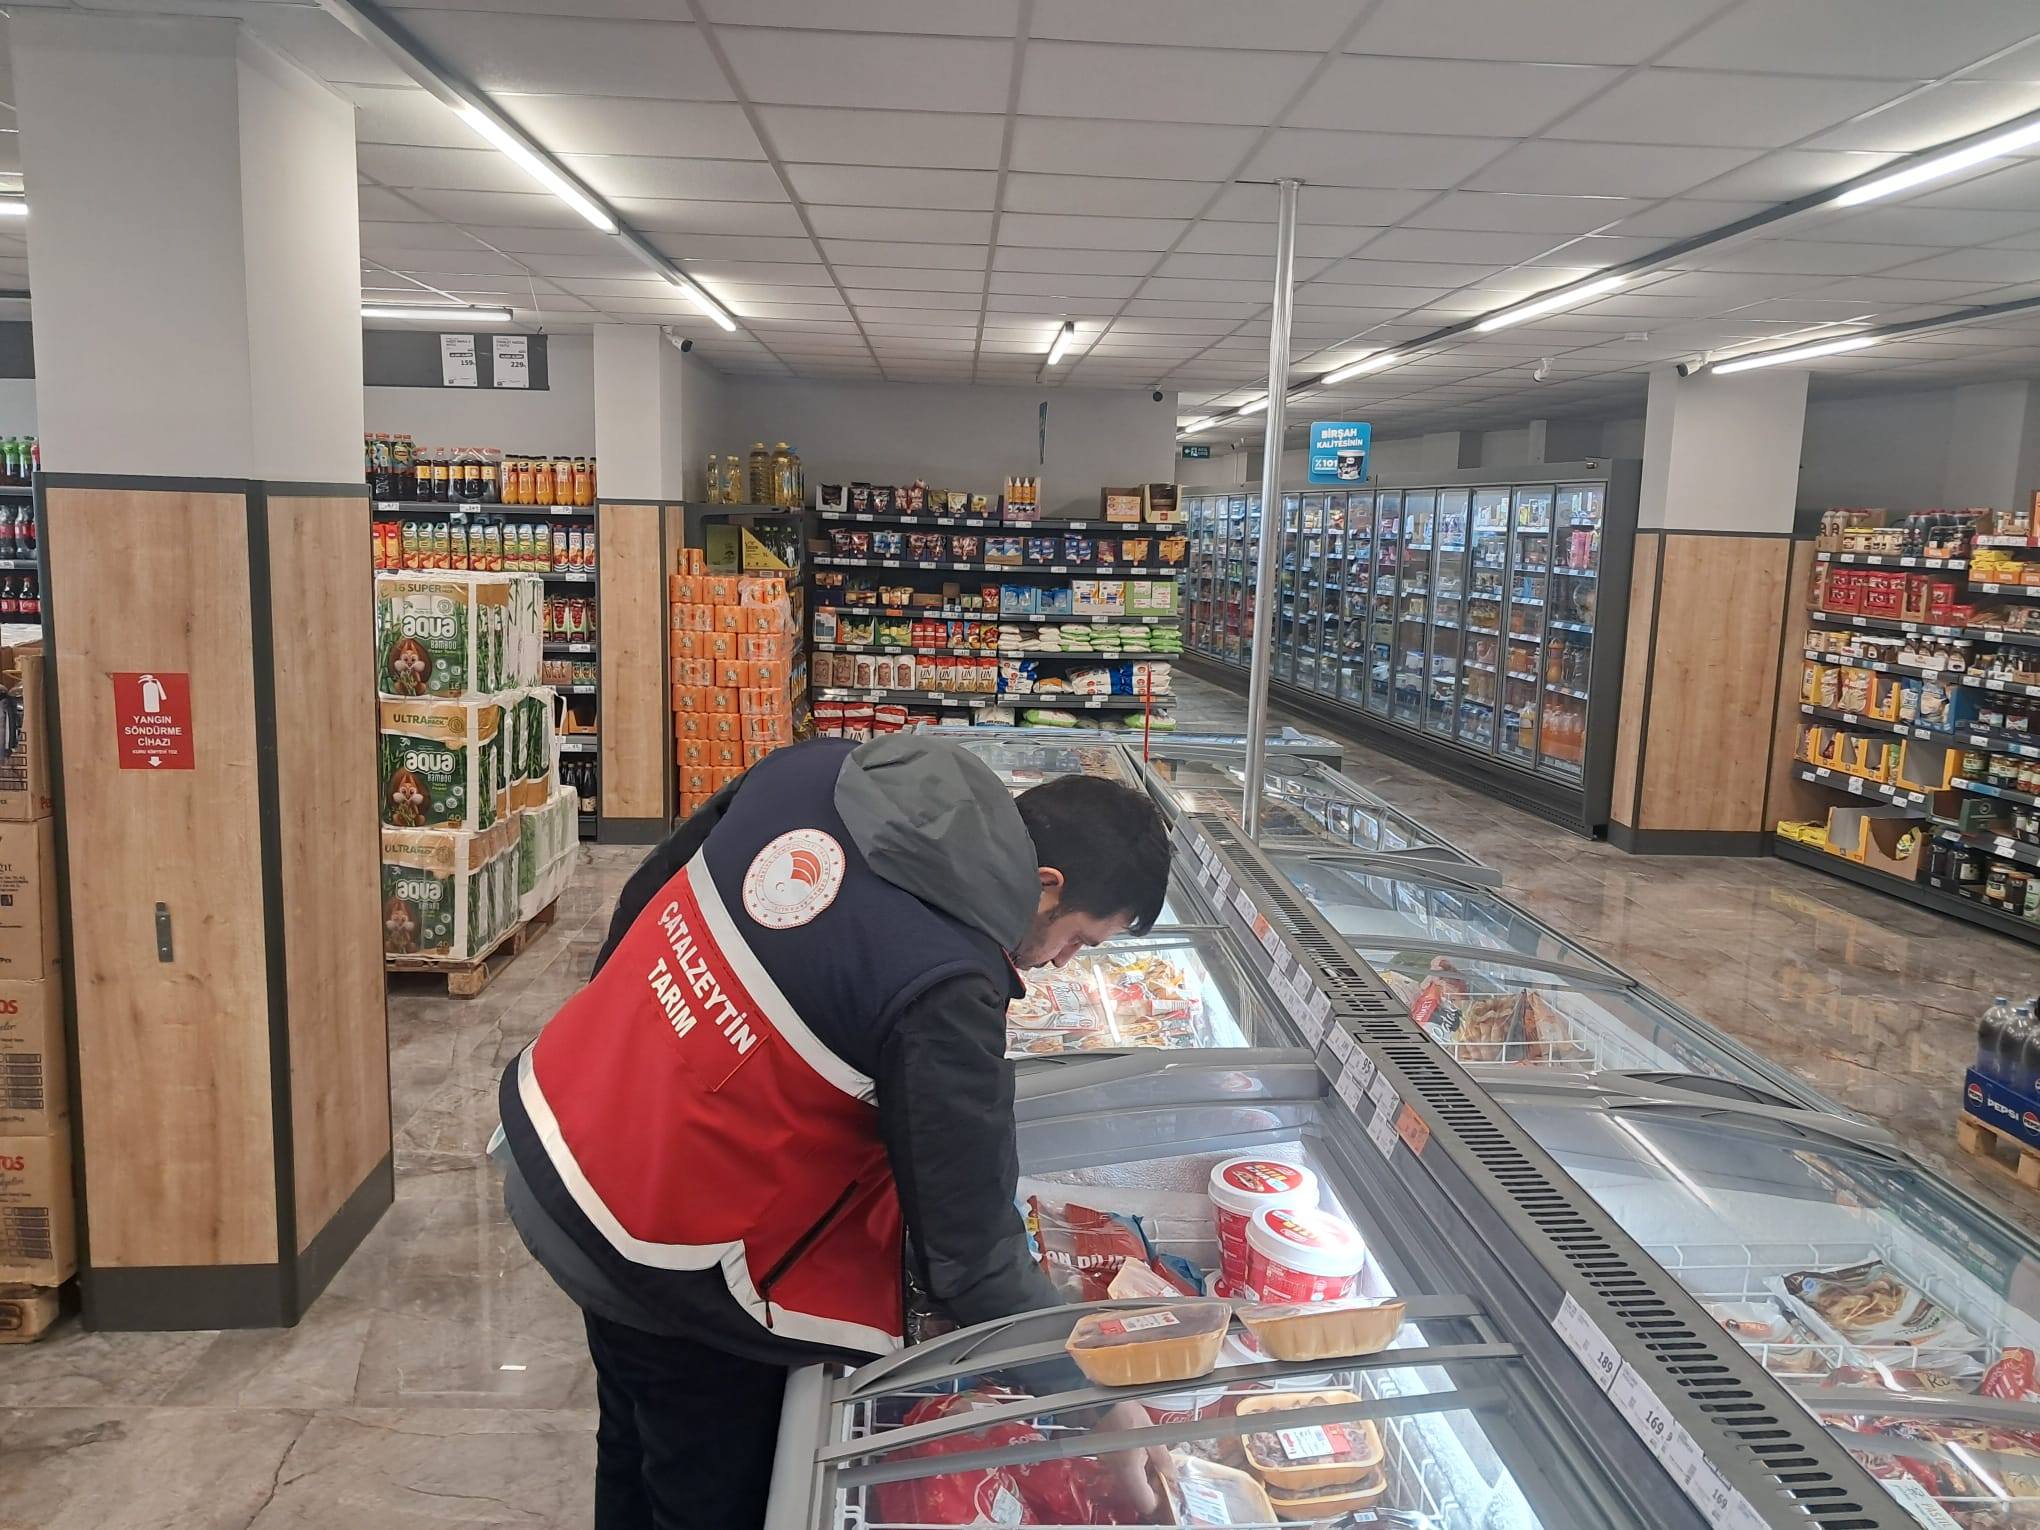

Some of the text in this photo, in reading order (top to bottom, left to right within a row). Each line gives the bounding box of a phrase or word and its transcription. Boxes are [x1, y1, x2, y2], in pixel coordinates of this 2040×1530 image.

[1316, 438, 1363, 448] KALİTESİNİN
[1321, 428, 1358, 440] BİRŞAH
[407, 584, 442, 593] SUPER
[402, 616, 457, 638] aqua
[133, 715, 172, 723] YANGIN
[393, 713, 427, 725] ULTRA
[124, 725, 182, 735] SÖNDÜRME
[137, 736, 171, 746] CİHAZI
[404, 751, 456, 772] aqua
[396, 880, 443, 900] aqua
[658, 901, 757, 1055] ÇATALZEYTİN
[648, 957, 697, 1038] TARIM
[1987, 1097, 2020, 1121] PEPSI
[1597, 1351, 1614, 1374] 189
[1645, 1411, 1665, 1435] 169
[1711, 1488, 1728, 1510] 169
